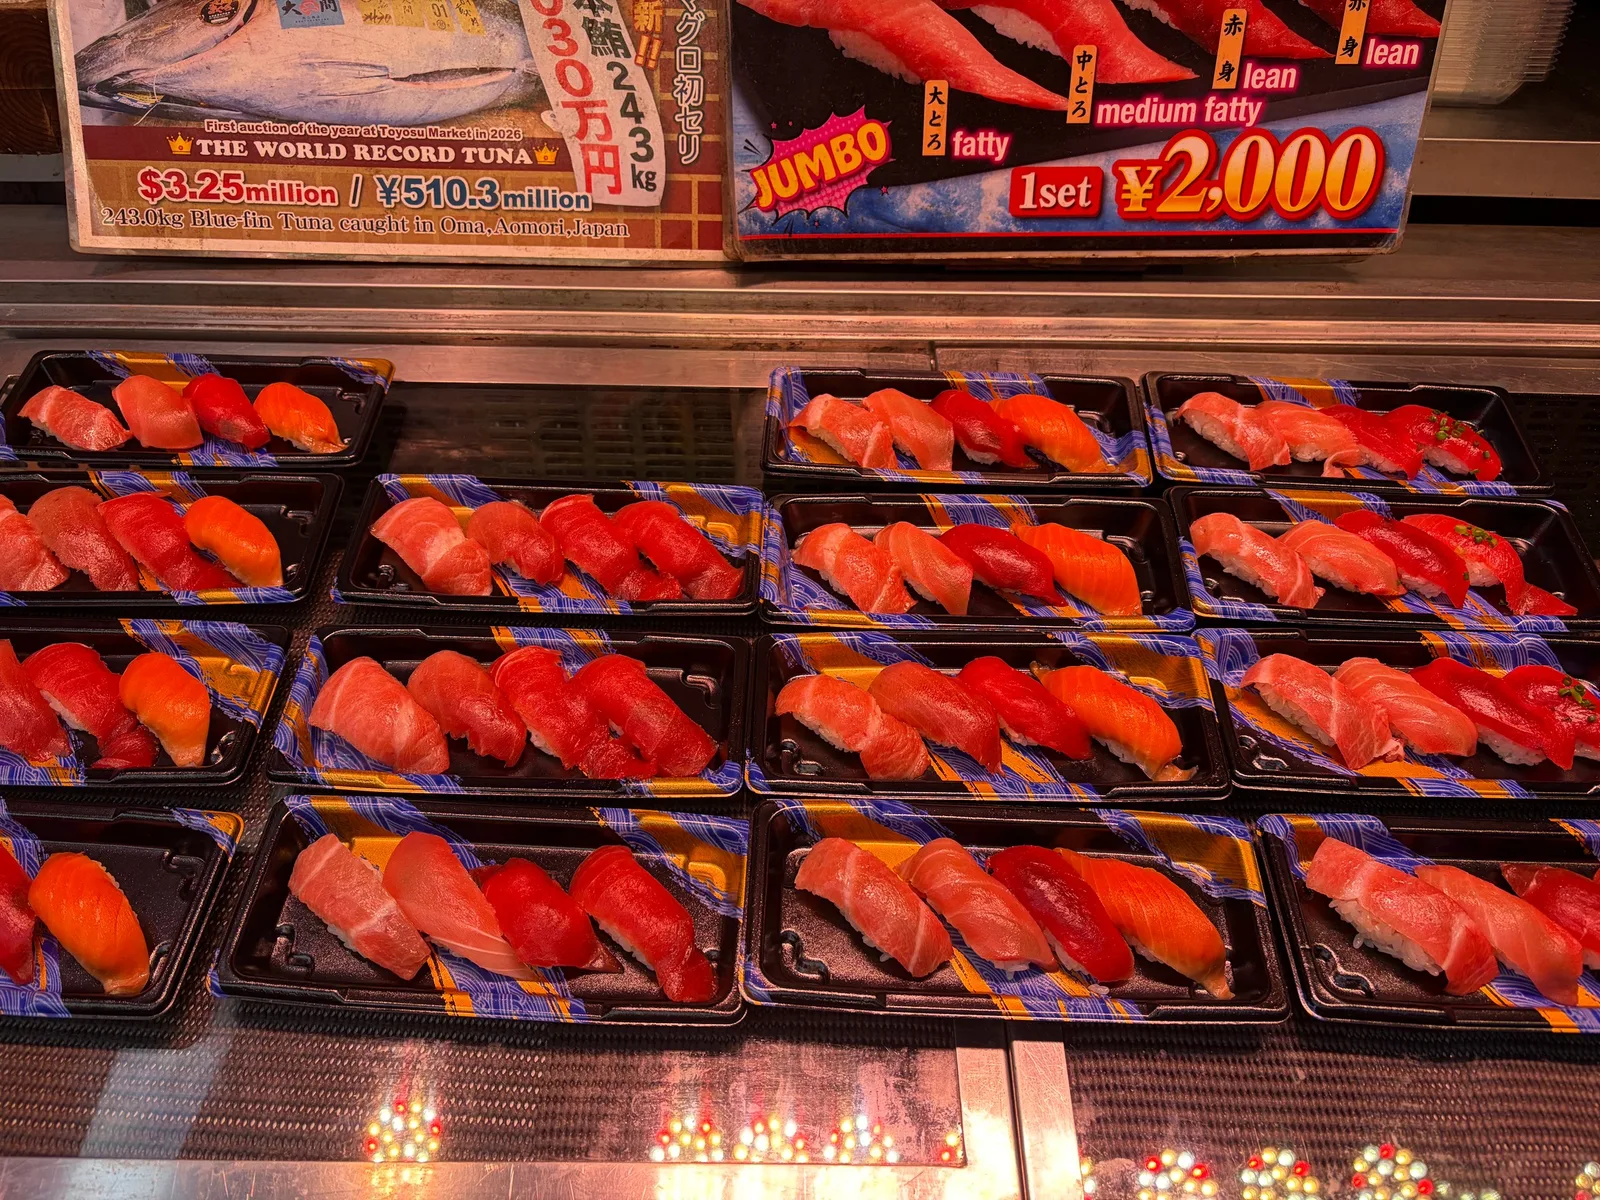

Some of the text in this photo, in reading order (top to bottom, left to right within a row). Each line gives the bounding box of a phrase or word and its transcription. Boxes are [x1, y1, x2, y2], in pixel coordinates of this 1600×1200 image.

[1217, 14, 1243, 82] 赤身
[1366, 39, 1419, 65] lean
[1072, 50, 1093, 118] 中とろ
[1243, 63, 1297, 88] lean
[927, 86, 945, 150] 大とろ
[1097, 96, 1262, 126] medium fatty
[205, 120, 521, 141] First auction of the year at Toyosu Market in 2026
[196, 140, 533, 164] THE WORLD RECORD TUNA
[953, 131, 1009, 161] fatty
[753, 122, 887, 208] JUMBO
[1019, 134, 1376, 212] 1set ¥2,000
[140, 166, 336, 205] $3.25million
[102, 209, 183, 228] 243.0kg
[192, 211, 272, 228] Blue-fin
[278, 213, 332, 231] Tuna
[338, 214, 408, 236] caught
[414, 219, 434, 232] in
